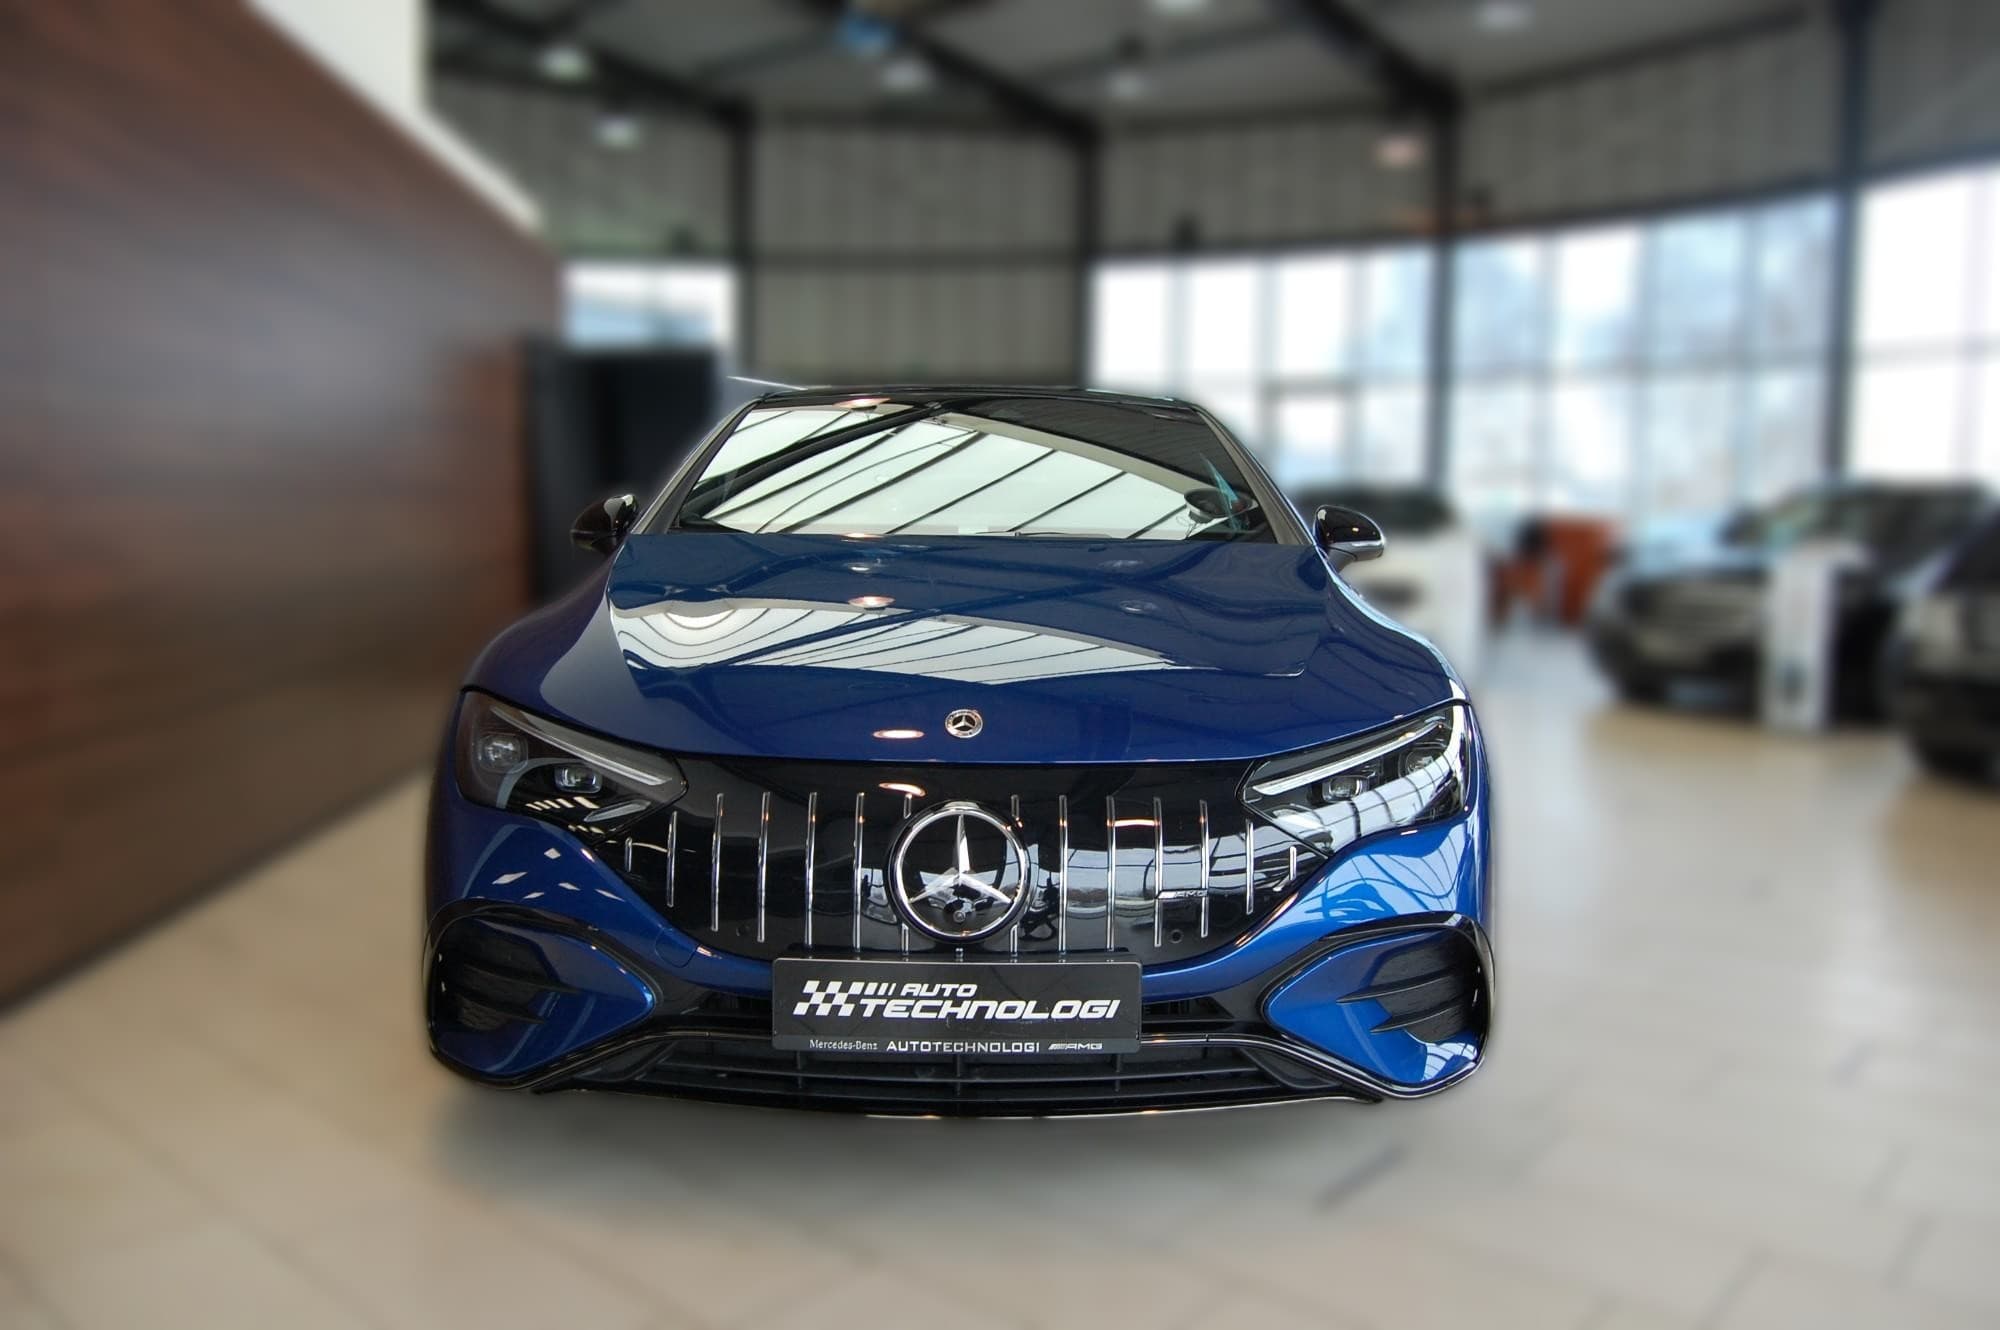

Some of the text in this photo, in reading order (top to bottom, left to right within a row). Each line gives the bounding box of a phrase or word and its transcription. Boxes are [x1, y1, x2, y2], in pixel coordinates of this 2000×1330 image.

[900, 983, 978, 997] AUTO
[859, 999, 1121, 1020] TECHNOLOGI
[809, 1038, 1103, 1053] Mercedes-Benz AUTOTECHNOLOGI AMG
